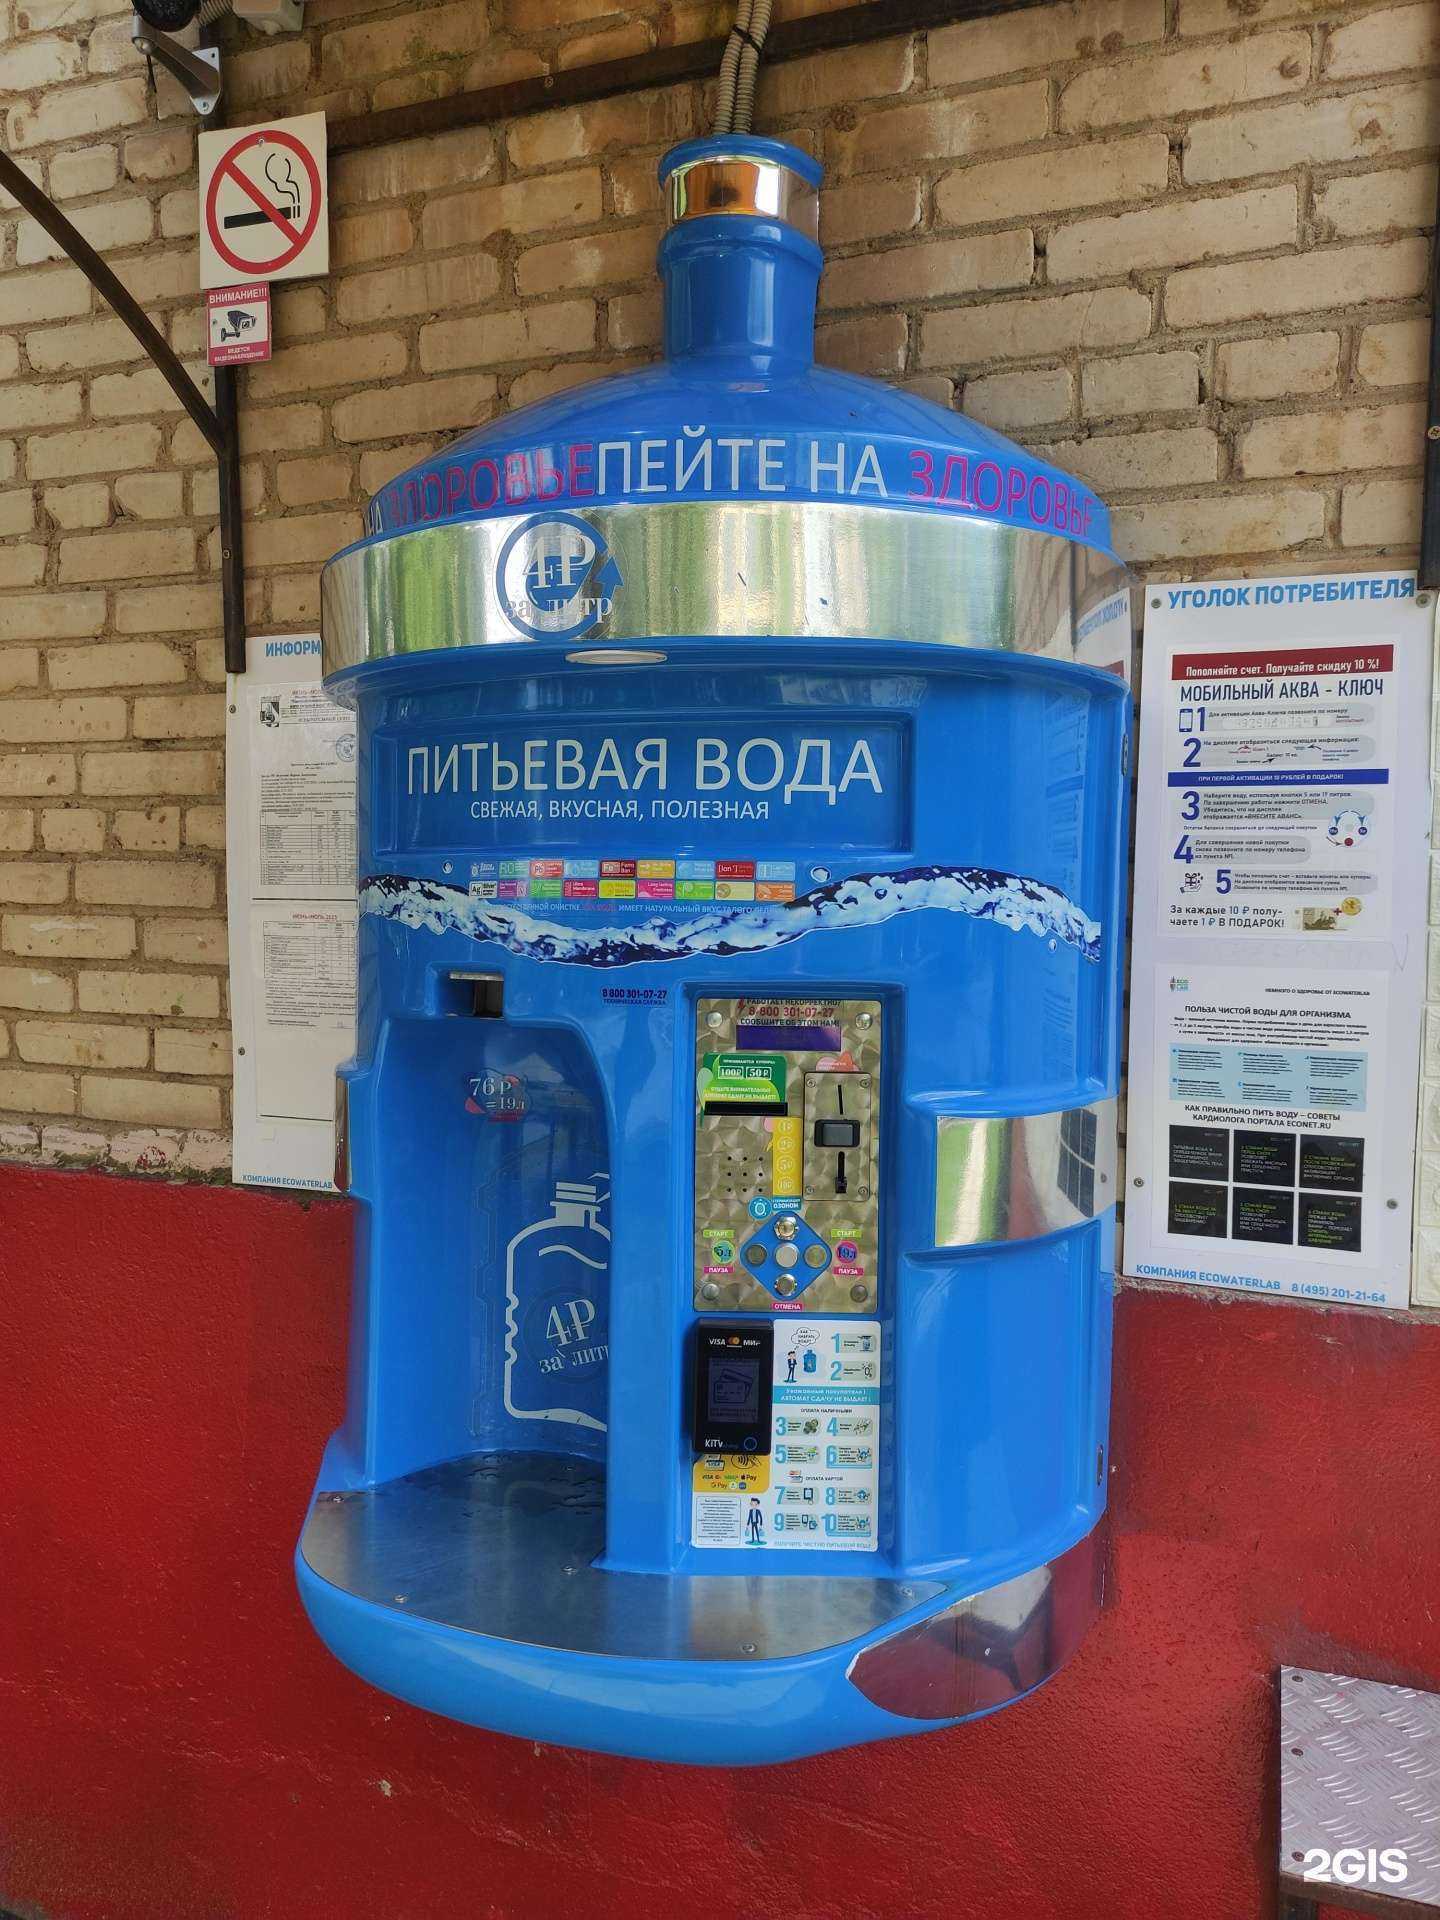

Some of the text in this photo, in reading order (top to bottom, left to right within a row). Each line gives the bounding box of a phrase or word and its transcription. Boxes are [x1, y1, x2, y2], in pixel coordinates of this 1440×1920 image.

[210, 288, 266, 303] ВНИМАНИЕ!!!
[598, 425, 786, 495] ПЕЙТЕ
[811, 440, 888, 497] НА
[908, 450, 1093, 538] ЗДОРОВЬЕ
[1168, 577, 1415, 609] УГОЛОК ПОТРЕБИТЕЛЯ
[1186, 659, 1380, 676] Пополняйте счет. Получайте скидку 10 %!
[1180, 679, 1383, 702] МОБИЛЬНЫЙ АКВА КЛЮЧ
[1197, 707, 1206, 731] 1
[1183, 738, 1201, 767] 2
[407, 738, 669, 795] ПИТЬЕВАЯ
[696, 738, 883, 806] ВОДА
[471, 799, 769, 822] СВЕЖАЯ, ВКУСНАЯ, ПОЛЕЗНАЯ
[1182, 791, 1200, 821] 3
[1174, 835, 1194, 864] 4
[1216, 869, 1231, 894] 5
[1170, 905, 1183, 914] За
[1186, 906, 1226, 915] каждые
[1229, 906, 1238, 914] 10
[1253, 907, 1283, 917] полу-
[1229, 919, 1285, 928] ПОДАРОК!
[602, 989, 667, 999] 8 800 301-07-27
[783, 1008, 834, 1017] 301-07-27
[1185, 1005, 1351, 1018] ПОЛЬЗА ЧИСТОЙ ВОДЫ ДЛЯ ОРГАНИЗМА
[469, 1078, 495, 1097] 76
[1193, 1114, 1331, 1129] КАРДИОЛОГА ПОРТАЛА ECONET.RU
[1202, 1106, 1250, 1115] ПРАВИЛЬНО
[1253, 1109, 1274, 1117] ПИТЬ
[1276, 1110, 1298, 1119] ВОДУ
[1307, 1113, 1340, 1121] СОВЕТЫ
[243, 1175, 332, 1188] КОМПАНИЯ ECOWATERLAB
[1136, 1264, 1386, 1303] КОМПАНИЯ ECOWATERLAB 8 (495) 201-21-64
[831, 1333, 840, 1353] 1
[831, 1361, 842, 1381] 2
[776, 1416, 786, 1436] 3
[827, 1417, 838, 1436] 4
[775, 1445, 786, 1463] 5
[826, 1445, 837, 1465] 6
[774, 1486, 786, 1504] 7
[826, 1487, 835, 1505] 8
[774, 1513, 784, 1531] 9
[821, 1514, 837, 1532] 10
